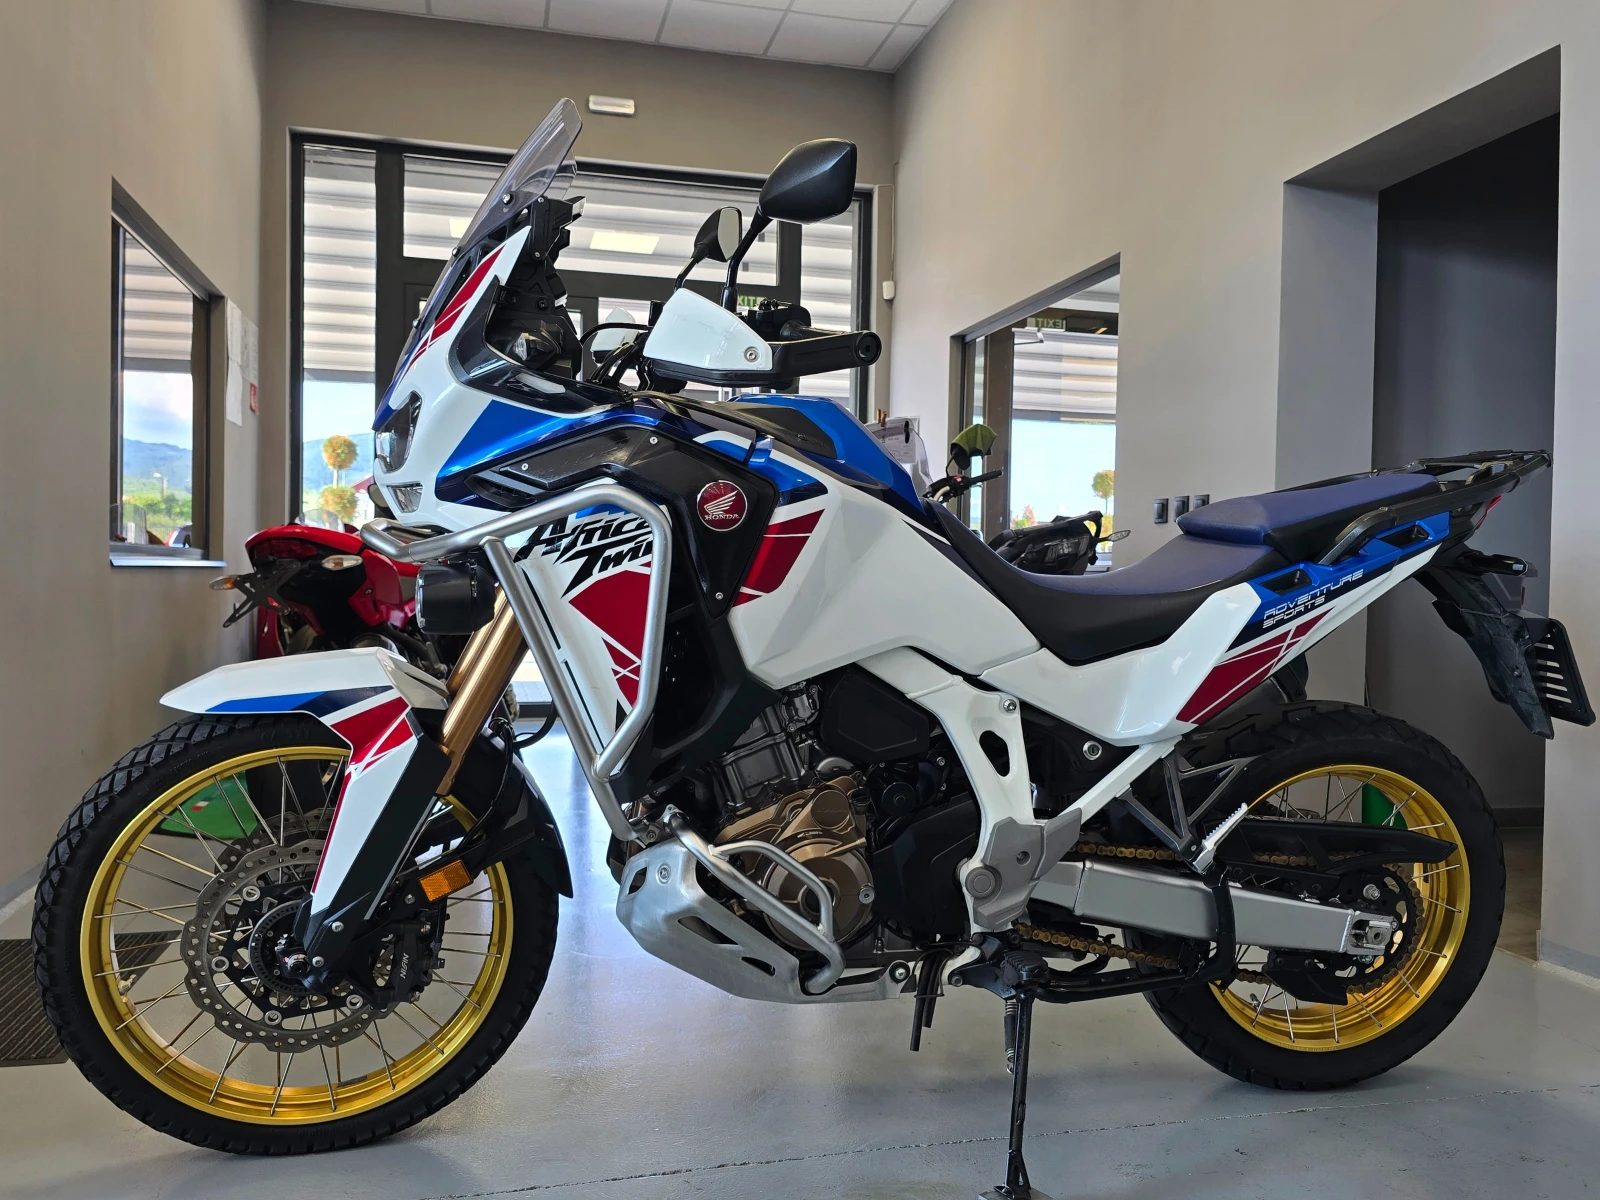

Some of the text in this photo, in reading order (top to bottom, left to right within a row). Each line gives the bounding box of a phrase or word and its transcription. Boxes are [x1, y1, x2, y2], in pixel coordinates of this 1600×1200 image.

[737, 295, 756, 308] XIT
[1263, 569, 1364, 619] ADVENTURE
[1262, 595, 1326, 628] SPORTS
[400, 953, 409, 979] NISSIN
